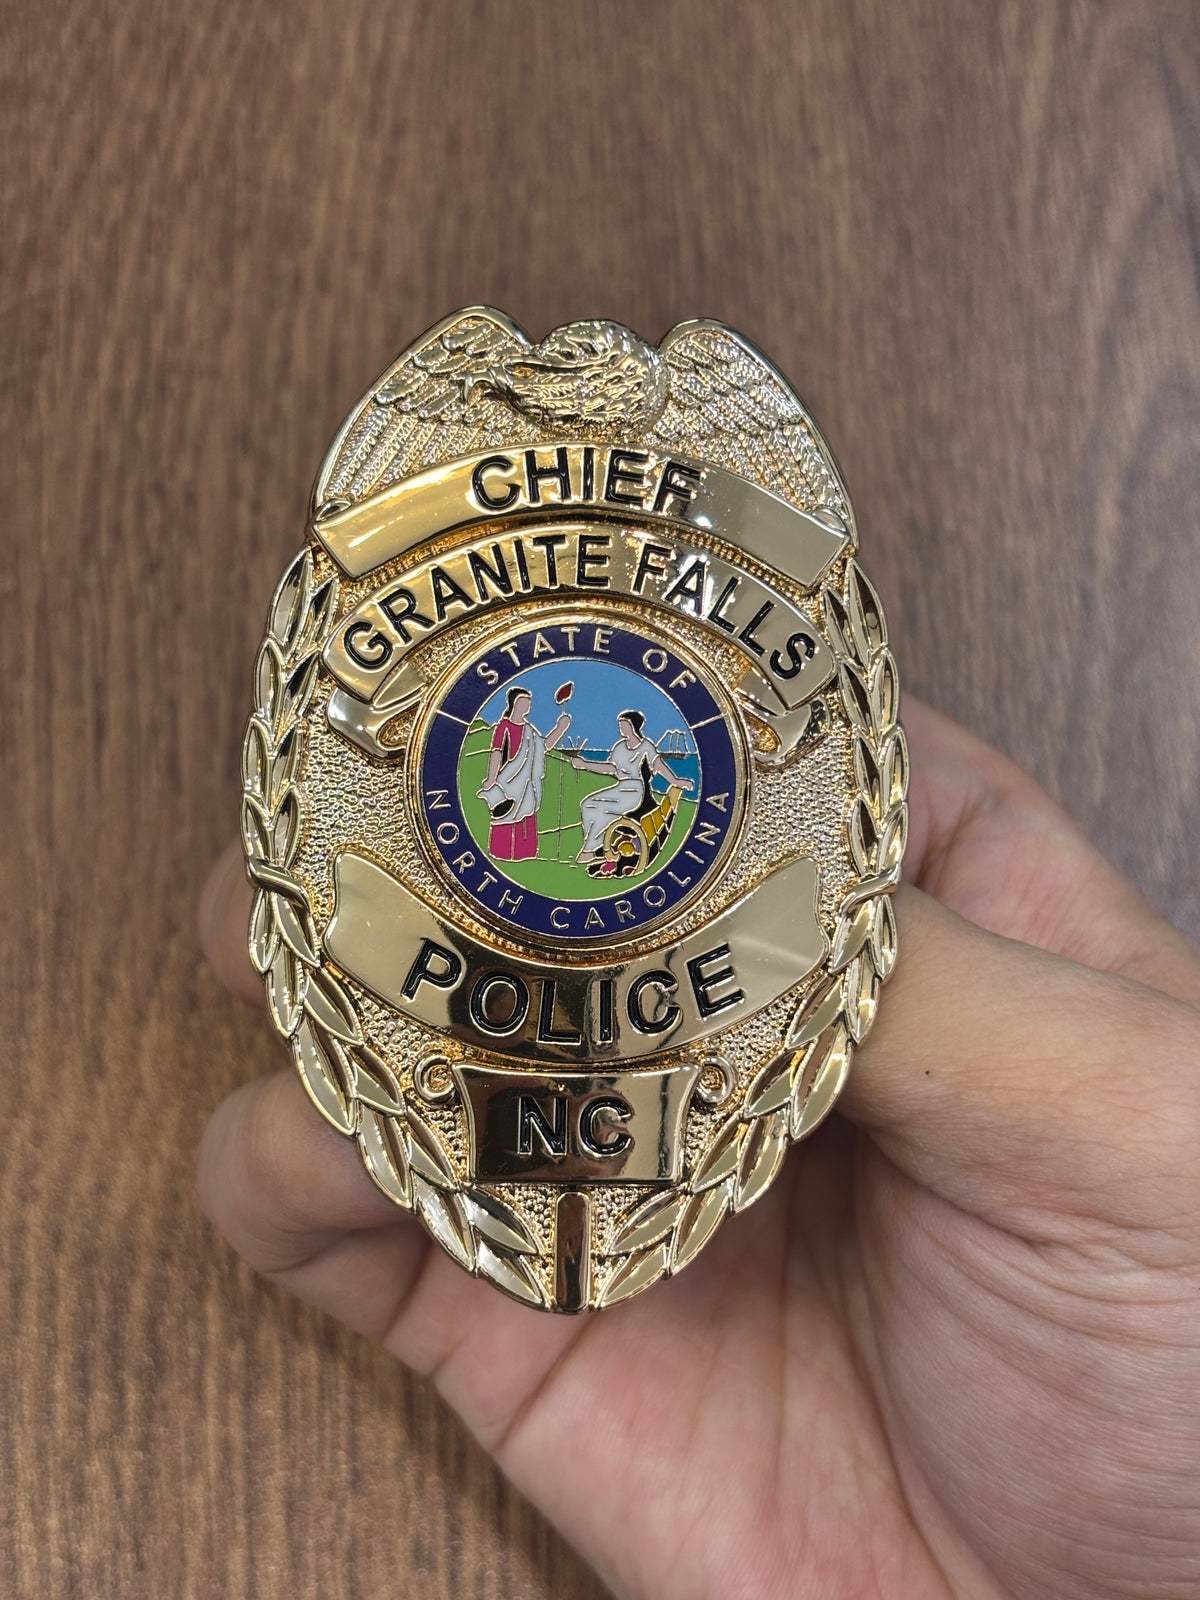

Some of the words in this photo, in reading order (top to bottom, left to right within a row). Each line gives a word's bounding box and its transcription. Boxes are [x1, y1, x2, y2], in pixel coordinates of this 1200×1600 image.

[472, 446, 701, 513] CHIEF
[343, 533, 613, 671] GRANITE
[631, 543, 816, 680] FALLS
[477, 626, 614, 685] STATE
[642, 649, 698, 689] OF
[426, 789, 524, 915] NORTH
[550, 791, 730, 930] CAROLINA
[400, 937, 746, 1046] POLICE
[517, 1095, 633, 1157] NC
